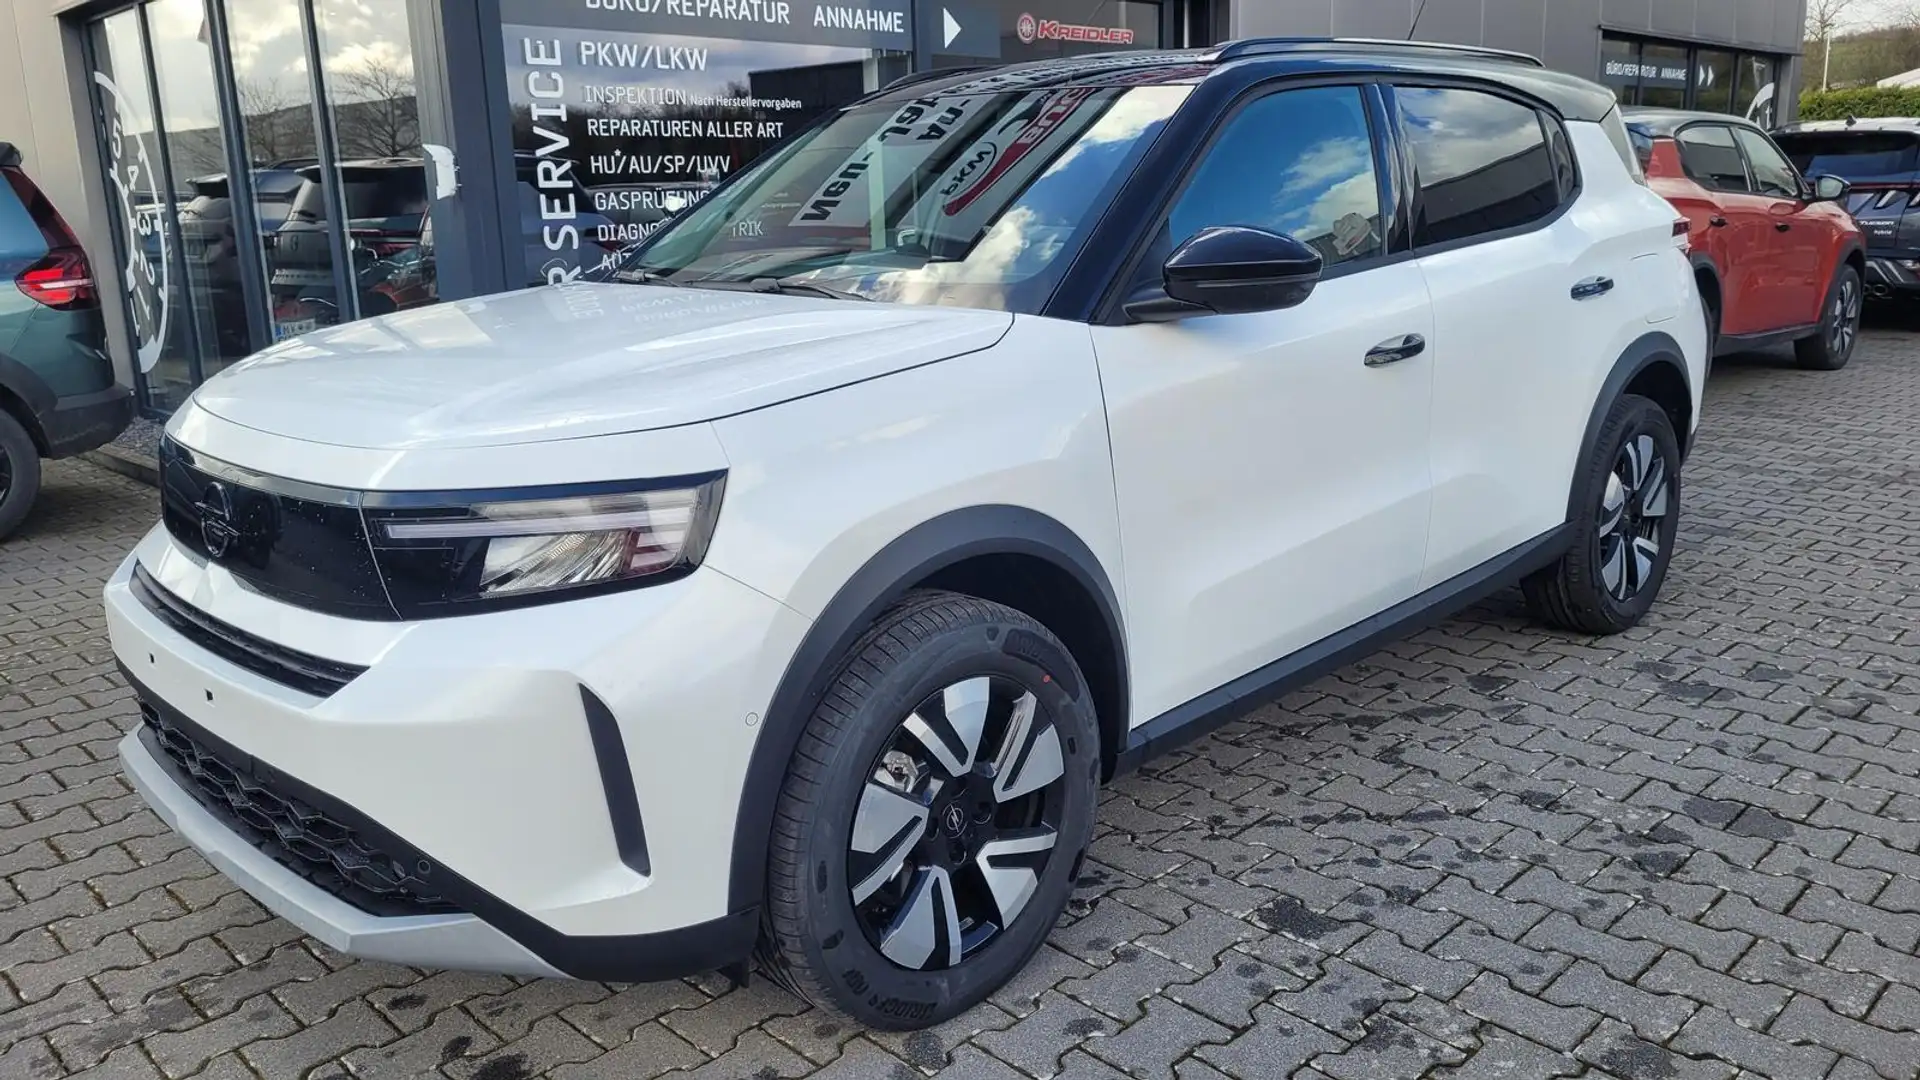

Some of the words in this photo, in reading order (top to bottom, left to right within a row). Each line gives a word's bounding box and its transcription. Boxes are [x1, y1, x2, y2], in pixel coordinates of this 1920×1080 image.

[813, 4, 905, 33] ANNAHME
[1038, 19, 1134, 45] KREIDLER
[580, 40, 708, 71] PKW/LKW
[585, 85, 688, 106] INSPEKTION
[689, 95, 714, 106] Nach
[716, 96, 802, 111] Herstellervorgaben
[586, 118, 704, 138] REPARATUREN
[706, 121, 753, 139] ALLER
[756, 122, 784, 139] ART
[523, 37, 580, 251] SERVICE
